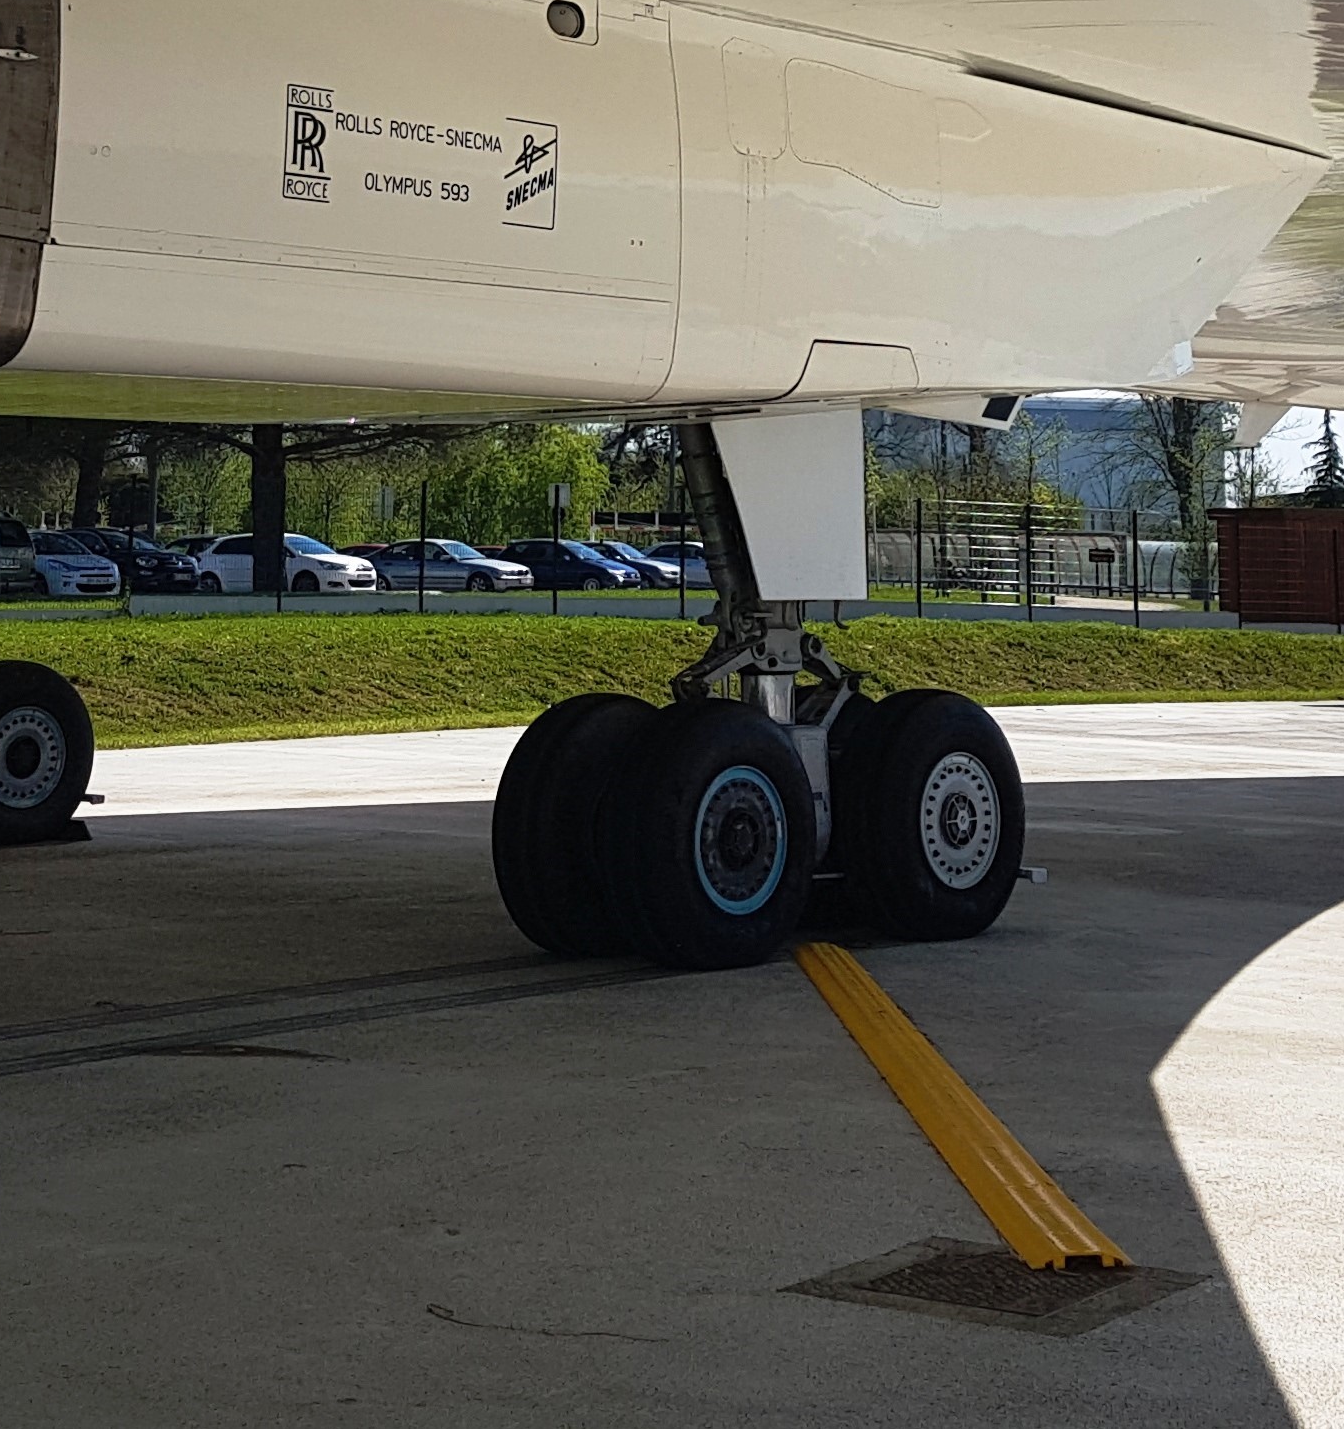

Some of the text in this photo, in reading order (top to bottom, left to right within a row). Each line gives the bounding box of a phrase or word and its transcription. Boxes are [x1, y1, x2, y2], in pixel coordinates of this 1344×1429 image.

[290, 87, 333, 109] ROLLS
[335, 112, 503, 154] ROLLS ROYCE-SNECMA
[285, 178, 328, 199] ROYCE
[364, 172, 470, 202] OLYMPUS 593
[505, 167, 554, 211] SNECMA
